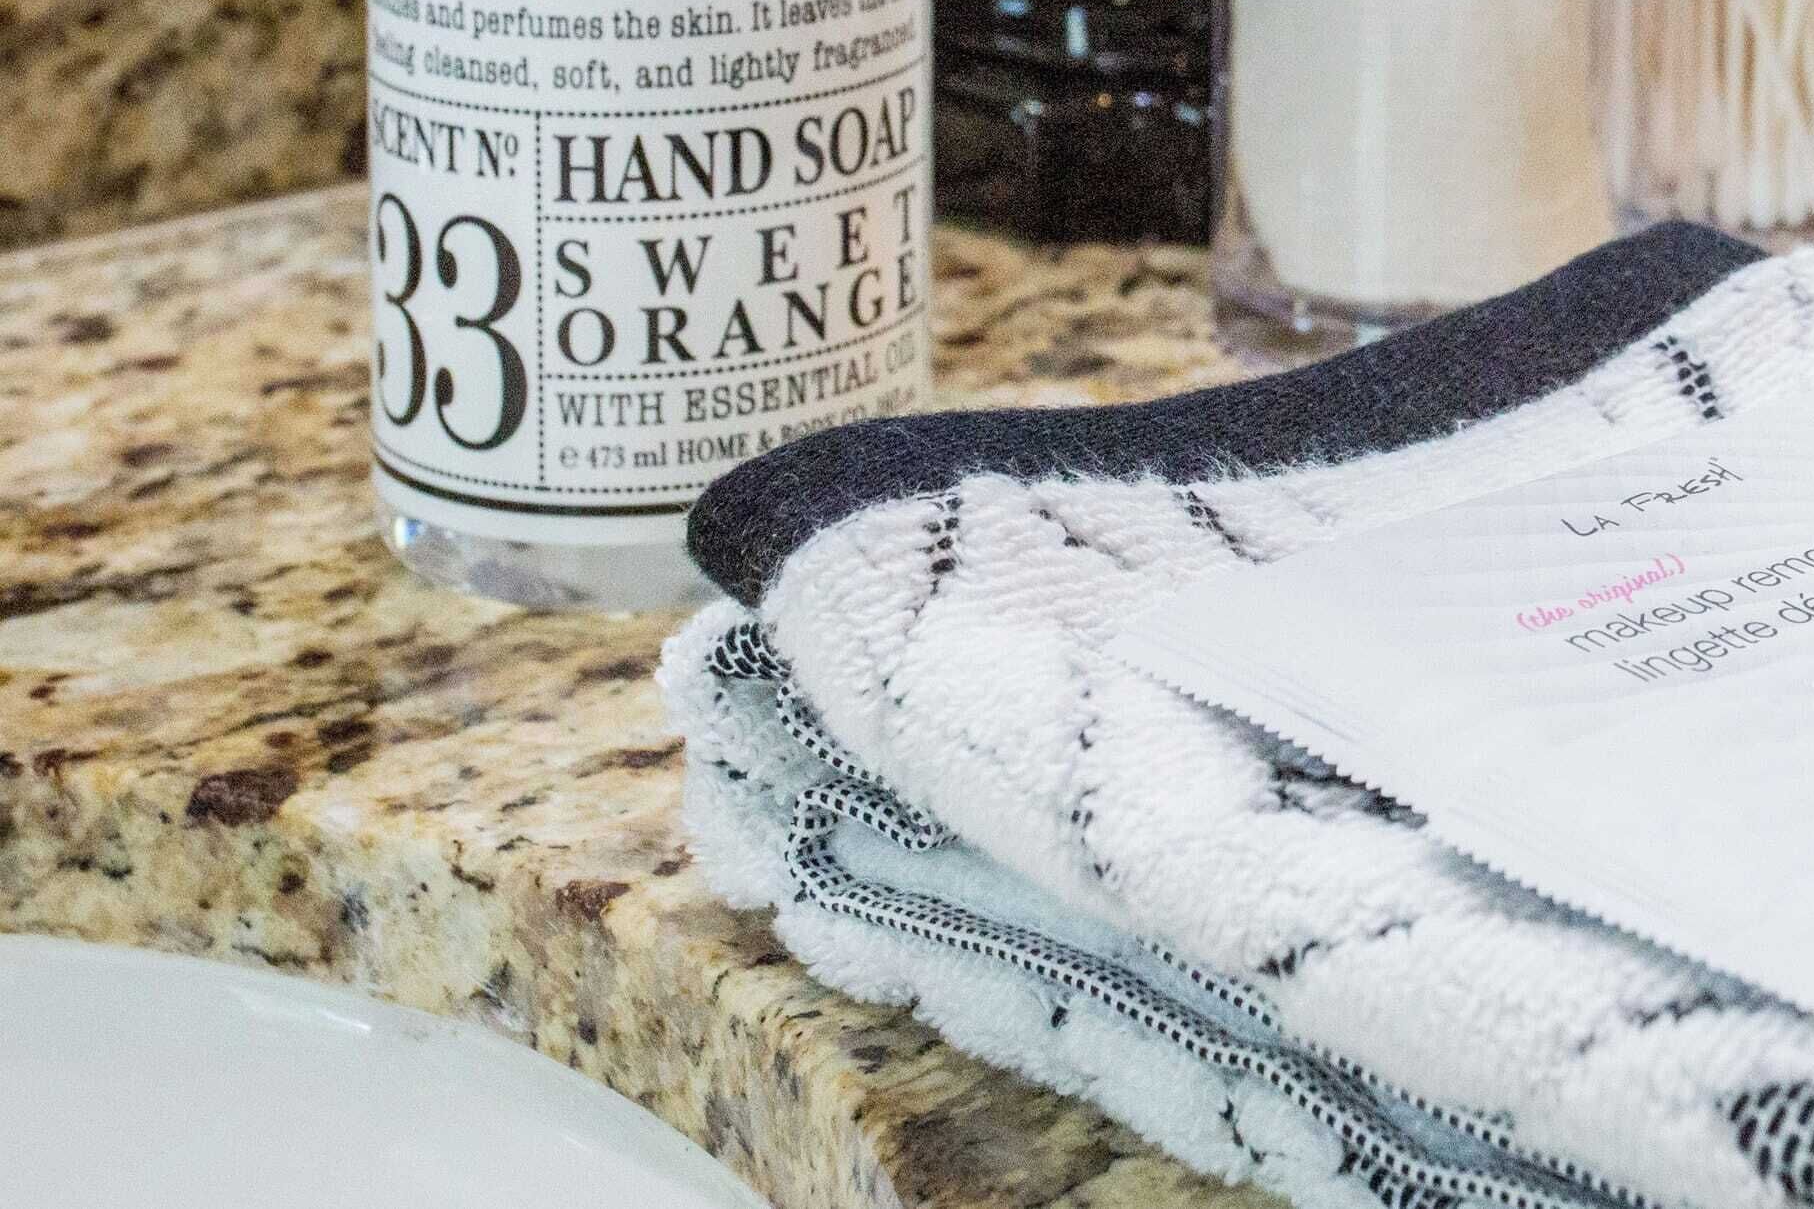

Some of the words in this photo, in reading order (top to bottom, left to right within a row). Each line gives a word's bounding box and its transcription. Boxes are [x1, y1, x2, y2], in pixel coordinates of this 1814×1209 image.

[425, 0, 465, 32] and
[473, 6, 603, 40] perfumes
[613, 9, 660, 40] the
[671, 5, 741, 39] skin.
[752, 0, 773, 32] It
[423, 44, 539, 90] cleansed,
[553, 58, 621, 91] soft,
[635, 56, 693, 89] and
[710, 48, 799, 90] lightly
[553, 126, 773, 203] HAND
[794, 87, 915, 186] SOAP
[376, 192, 528, 452] 33
[557, 250, 916, 367] ORANGE
[556, 389, 666, 428] WITH
[683, 348, 879, 423] ESSENTIAL
[586, 445, 626, 469] 473
[632, 441, 668, 468] ml
[677, 432, 749, 466] HOME
[1561, 515, 1620, 537] LA
[1620, 458, 1744, 512] FRESH
[1564, 589, 1735, 653] makeup
[1614, 620, 1779, 683] lingette
